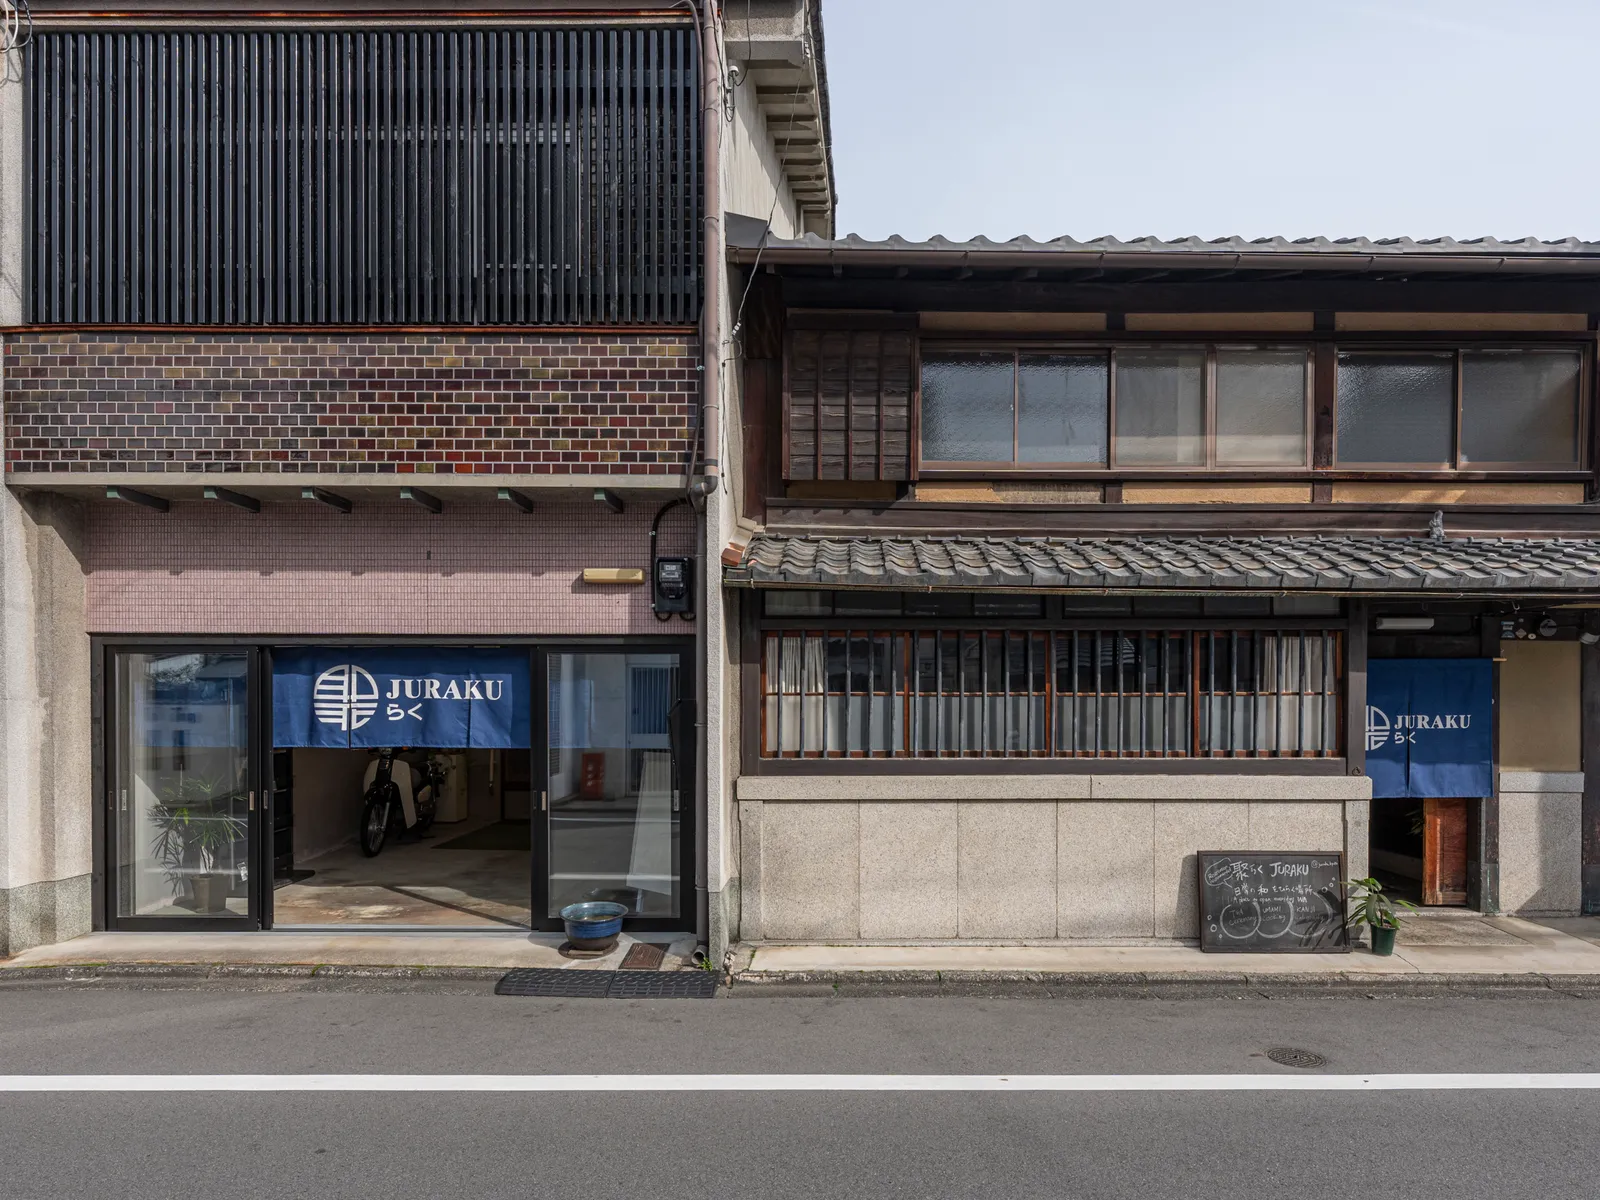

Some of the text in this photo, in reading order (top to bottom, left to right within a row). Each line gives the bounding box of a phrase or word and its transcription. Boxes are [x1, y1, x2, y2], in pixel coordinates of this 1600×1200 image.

[386, 679, 503, 700] JURAKU
[386, 703, 423, 721] らく
[1394, 714, 1472, 729] JURAKU
[1394, 731, 1417, 744] らく
[1269, 861, 1309, 877] JURAKU
